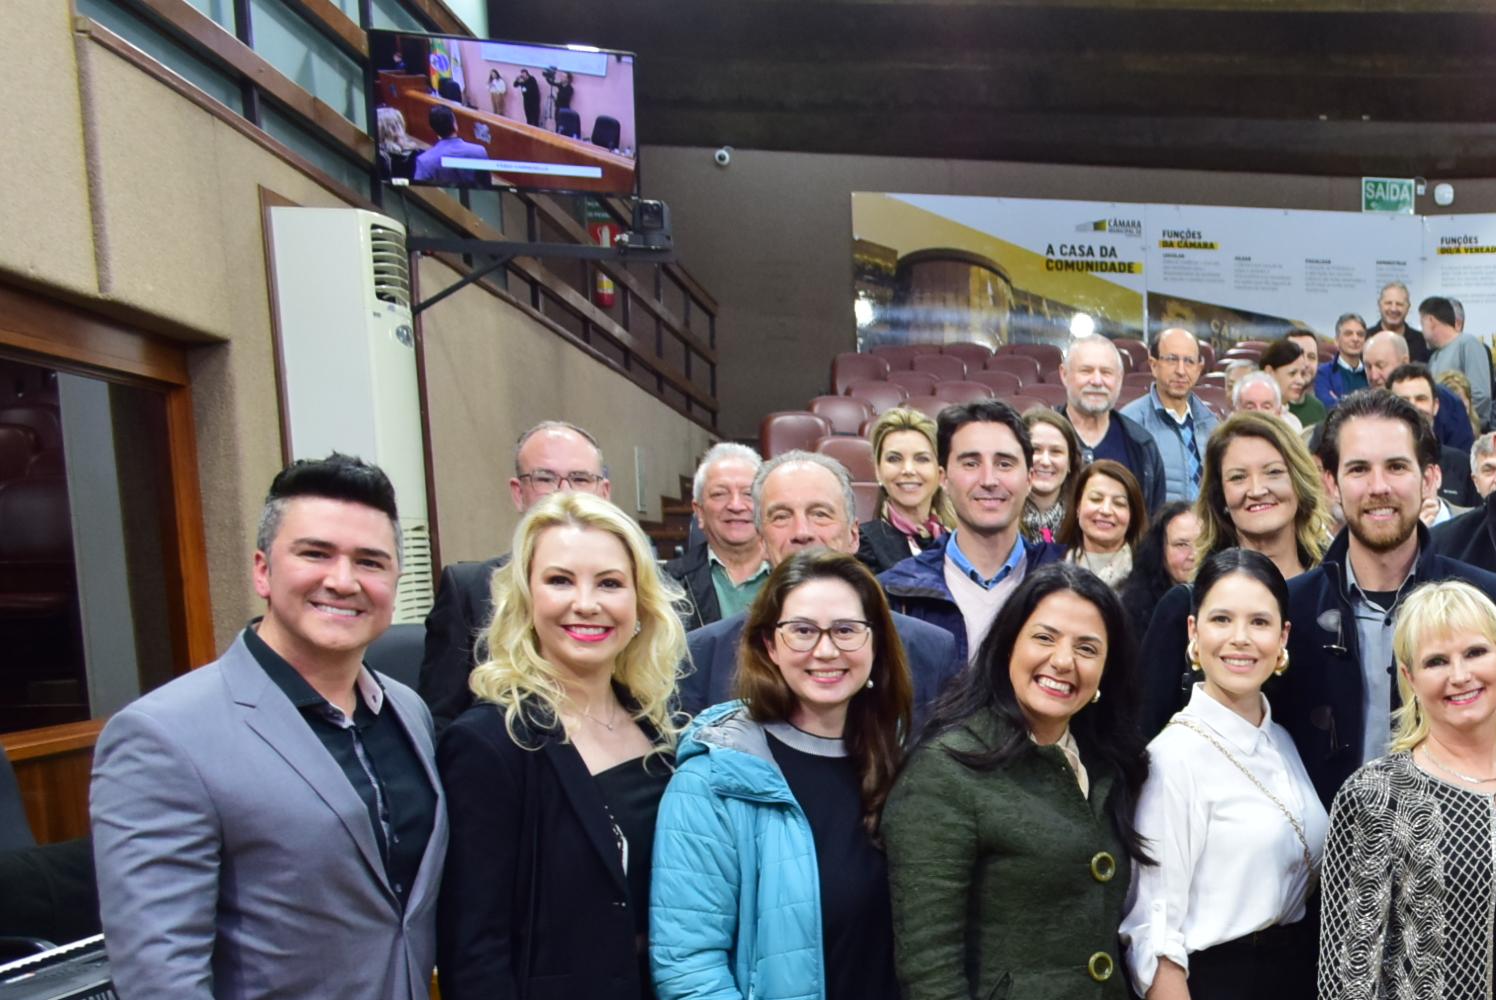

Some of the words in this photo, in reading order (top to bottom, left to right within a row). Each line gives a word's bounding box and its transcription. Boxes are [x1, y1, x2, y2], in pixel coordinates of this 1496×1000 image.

[1366, 181, 1410, 200] SAÍDA
[1108, 218, 1142, 228] CÂMARA
[1162, 228, 1202, 240] FUNÇÕES
[1440, 235, 1478, 245] FUNÇÕES
[1177, 239, 1215, 249] CÂMARA
[1045, 244, 1055, 256] A
[1059, 244, 1095, 258] CASA
[1100, 246, 1118, 258] DA
[1045, 259, 1135, 274] COMUNIDADE
